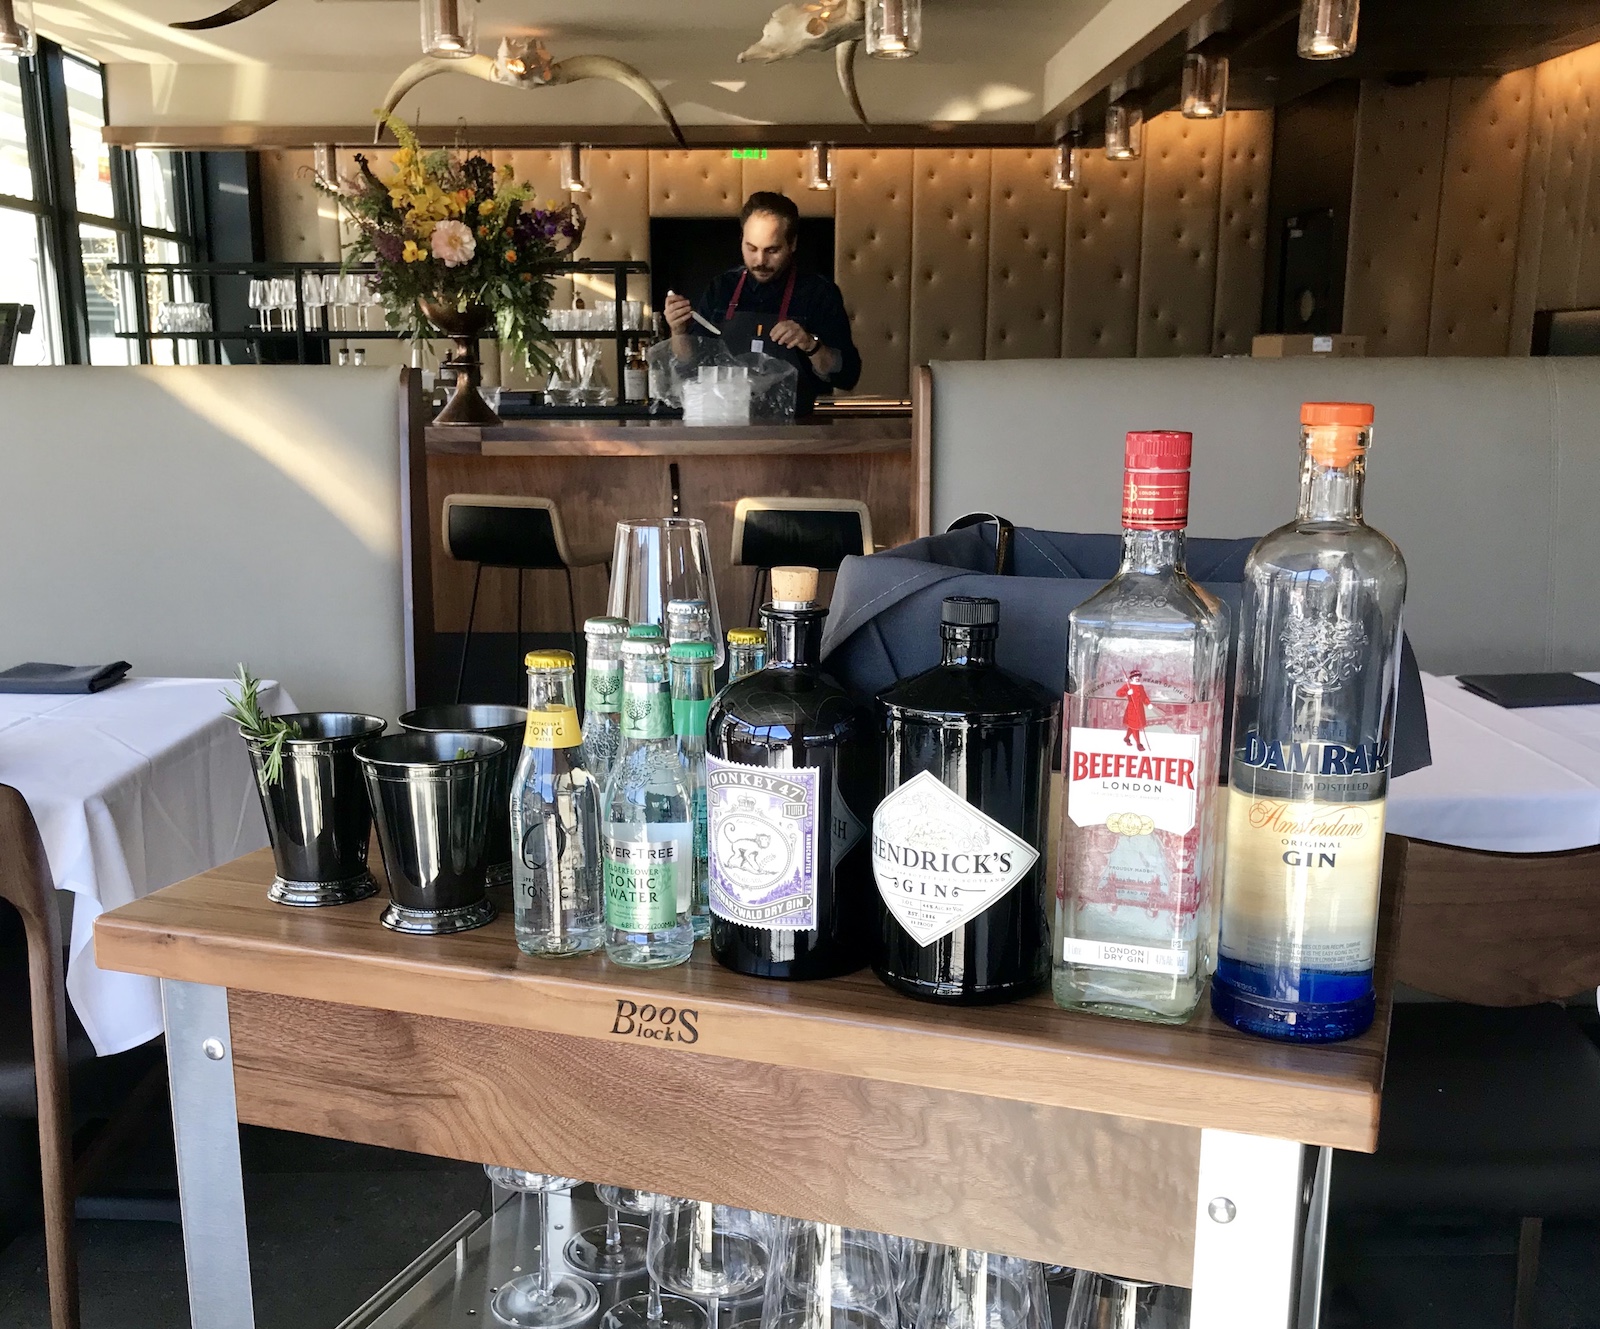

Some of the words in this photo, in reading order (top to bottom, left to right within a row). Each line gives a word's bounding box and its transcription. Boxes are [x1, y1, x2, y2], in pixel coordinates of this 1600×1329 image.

[1122, 507, 1154, 516] PORTED
[528, 726, 563, 736] TONIC
[1245, 732, 1388, 776] DAMRAK
[1072, 751, 1195, 790] BEEFEATER
[710, 772, 778, 791] MONKEY
[778, 784, 801, 798] 47
[1102, 781, 1163, 793] LONDON
[1317, 782, 1369, 792] DISTILLED
[1249, 800, 1369, 839] Amsterdam
[1281, 838, 1342, 849] ORIGINAL
[1282, 850, 1337, 868] GIN
[608, 863, 659, 876] ELDERFLOWER
[609, 872, 656, 889] TONIC
[902, 879, 948, 898] GIN
[608, 885, 659, 903] WATER
[764, 904, 786, 918] DRY
[786, 898, 804, 911] GIN
[1103, 946, 1145, 957] LONDON
[1103, 952, 1124, 962] DRY
[1127, 955, 1145, 964] GIN
